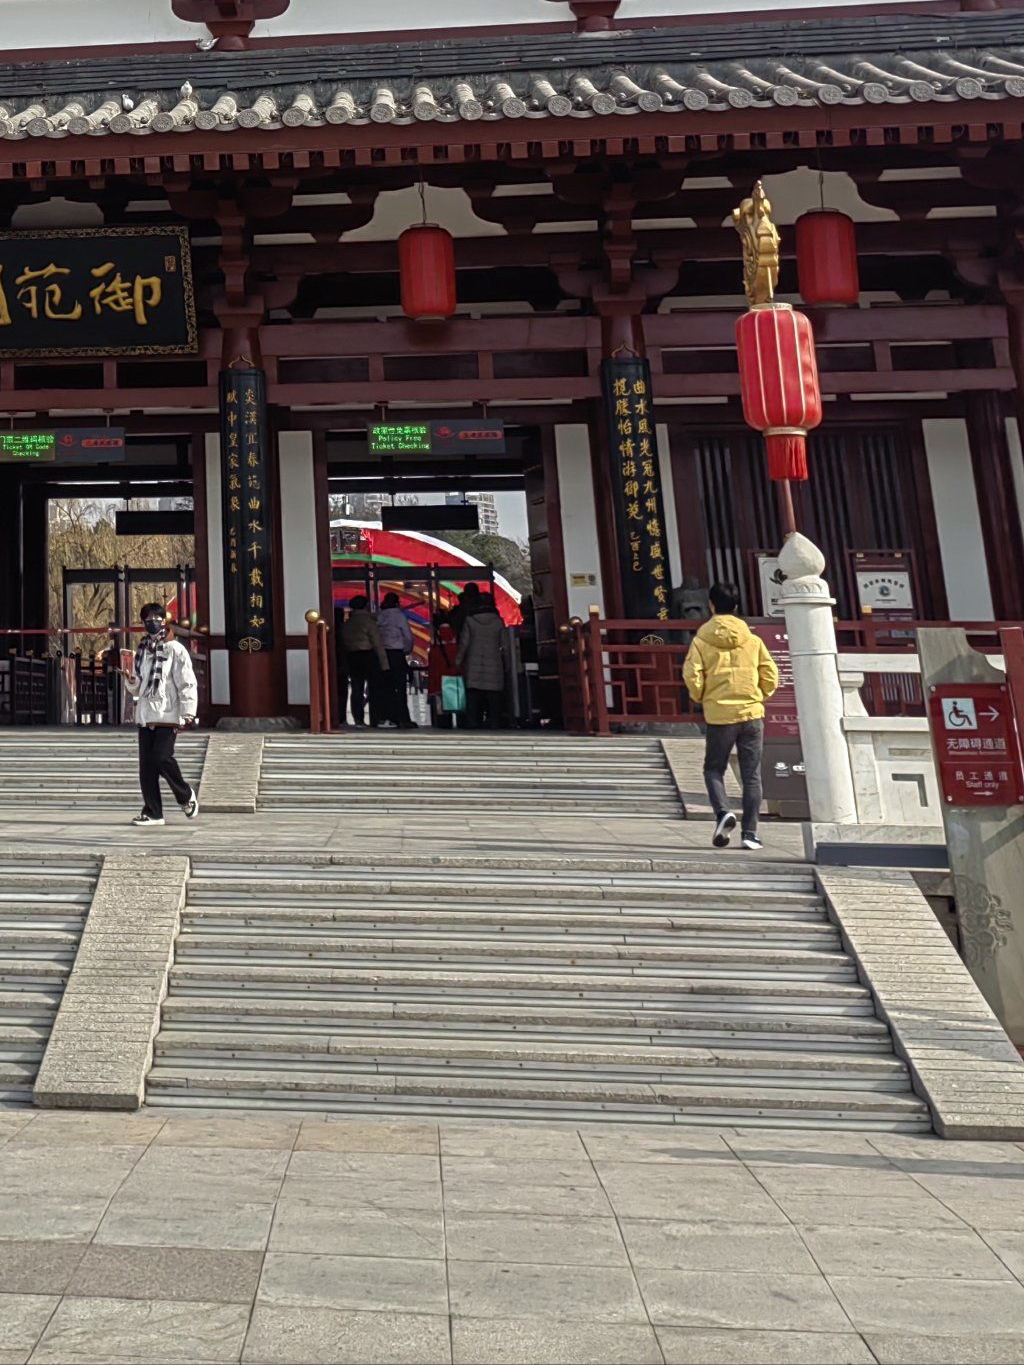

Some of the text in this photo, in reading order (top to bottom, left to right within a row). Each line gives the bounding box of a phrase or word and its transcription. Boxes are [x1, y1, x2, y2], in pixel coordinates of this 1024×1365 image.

[946, 738, 1007, 750] 无障碍通道
